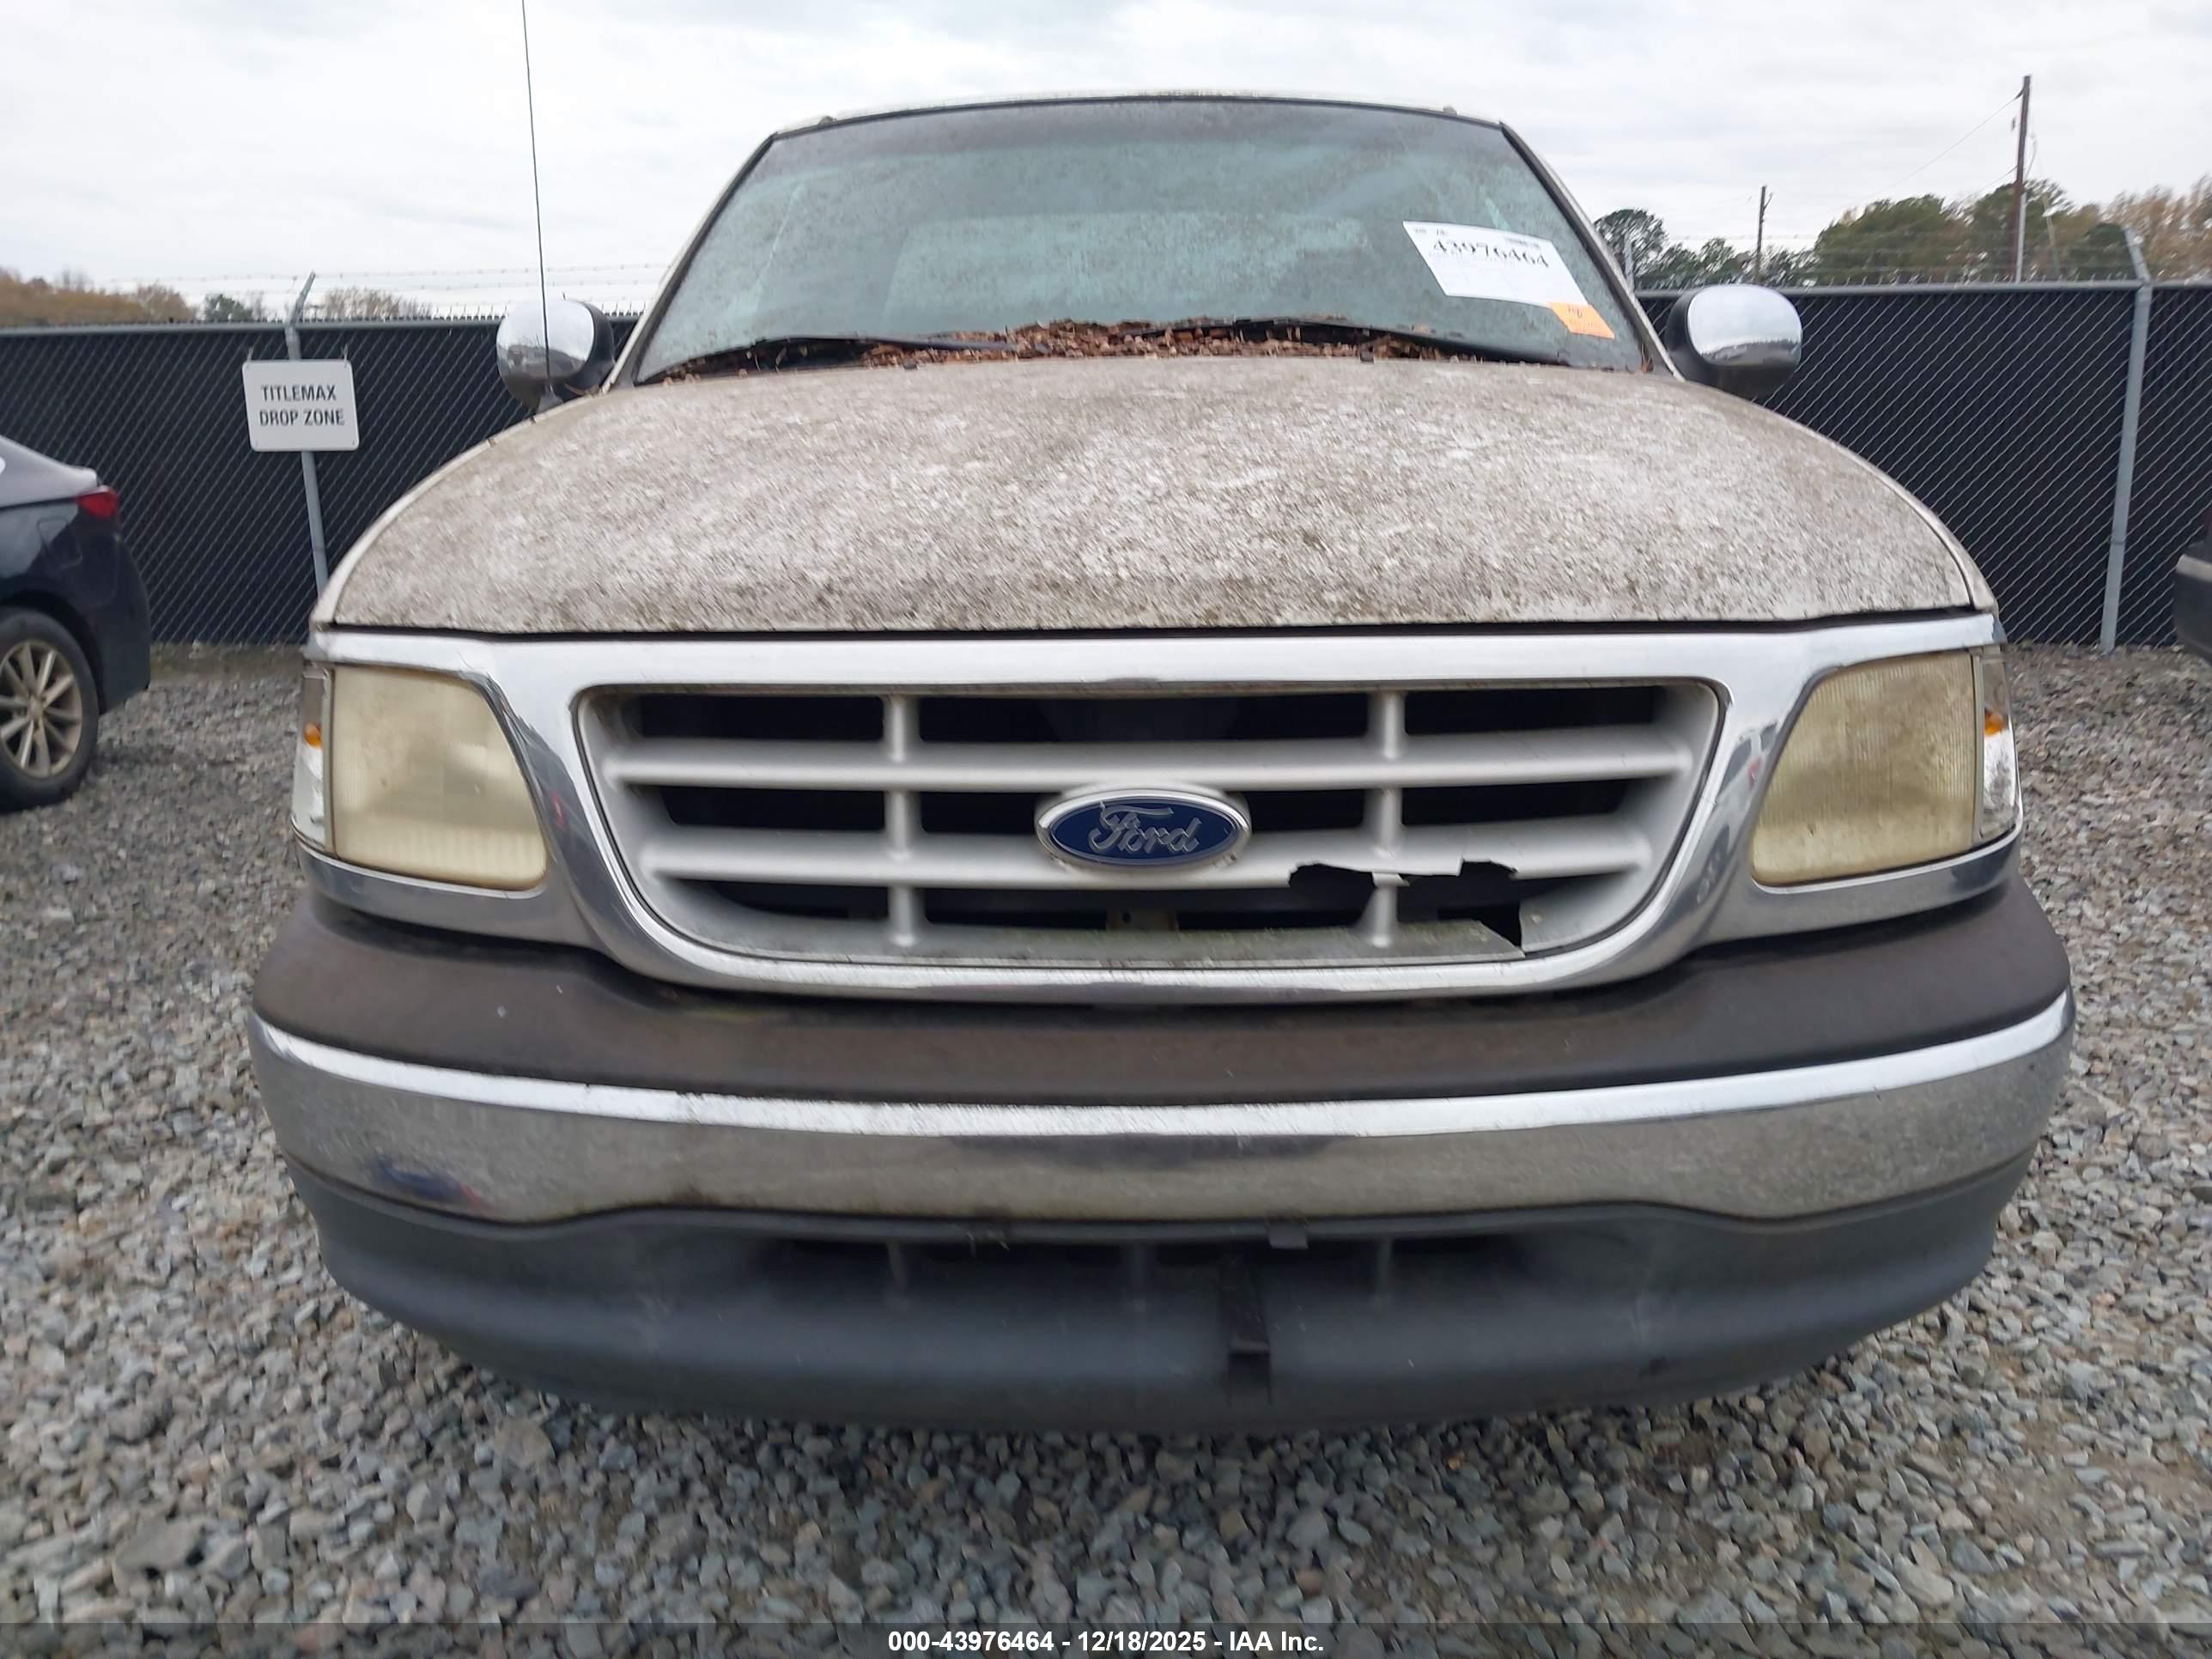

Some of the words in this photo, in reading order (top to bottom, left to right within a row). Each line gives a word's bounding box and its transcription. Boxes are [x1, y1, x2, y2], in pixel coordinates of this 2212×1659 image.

[261, 384, 337, 402] TITLEMAX
[259, 408, 299, 427] DROP
[303, 408, 345, 427] ZONE
[1088, 801, 1203, 854] Ford
